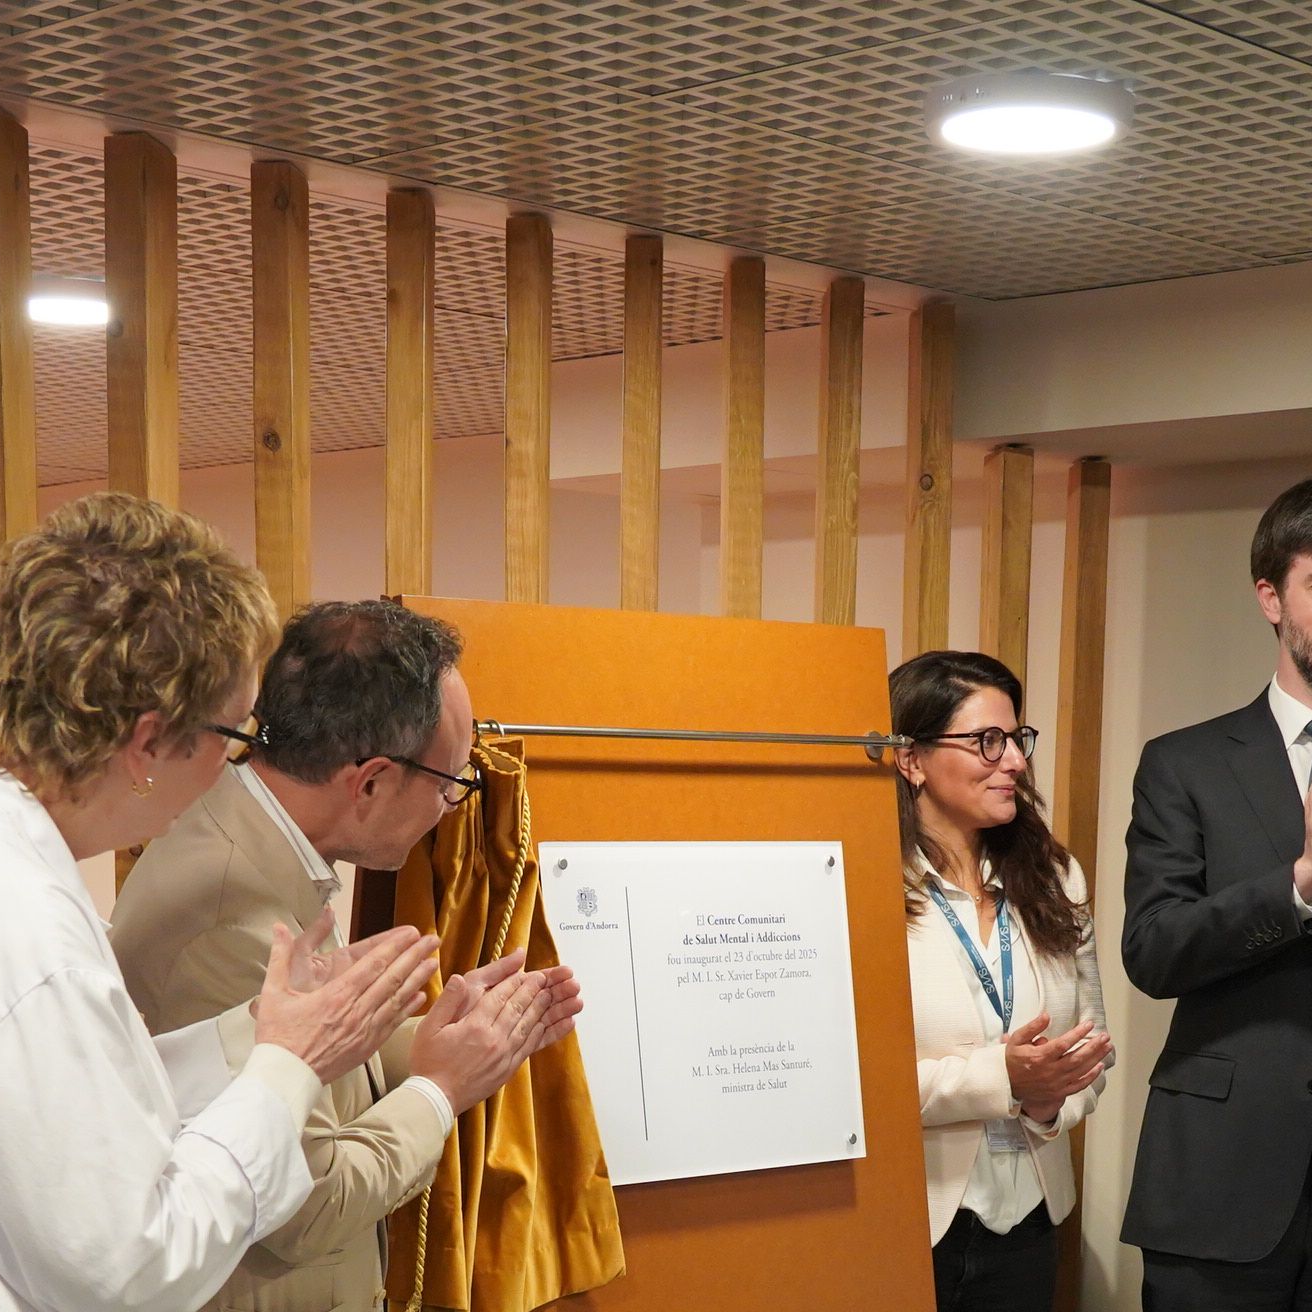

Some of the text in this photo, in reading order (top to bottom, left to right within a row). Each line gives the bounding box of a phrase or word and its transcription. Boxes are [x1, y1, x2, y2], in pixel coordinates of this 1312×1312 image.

[559, 921, 619, 931] Govern d'Andorra
[696, 913, 786, 926] El Centre Comunitari
[682, 931, 801, 946] de Salut Mental i Addiccions
[667, 953, 682, 965] fou
[683, 953, 723, 967] inaugurat
[724, 952, 732, 962] el
[733, 951, 744, 962] 23
[745, 949, 783, 962] d'octubre
[784, 949, 797, 961] del
[677, 972, 690, 988] pel
[692, 972, 705, 983] M.
[715, 970, 726, 982] Sr.
[728, 969, 753, 981] Xavier
[755, 968, 777, 983] Espot
[719, 987, 776, 1004] cap de Govern
[708, 1040, 796, 1059] Amb la presència de la
[692, 1066, 705, 1078] M.
[715, 1064, 731, 1076] Sra.
[733, 1062, 761, 1075] Helena
[763, 1060, 780, 1072] Mas
[722, 1078, 788, 1093] ministra de Salut
